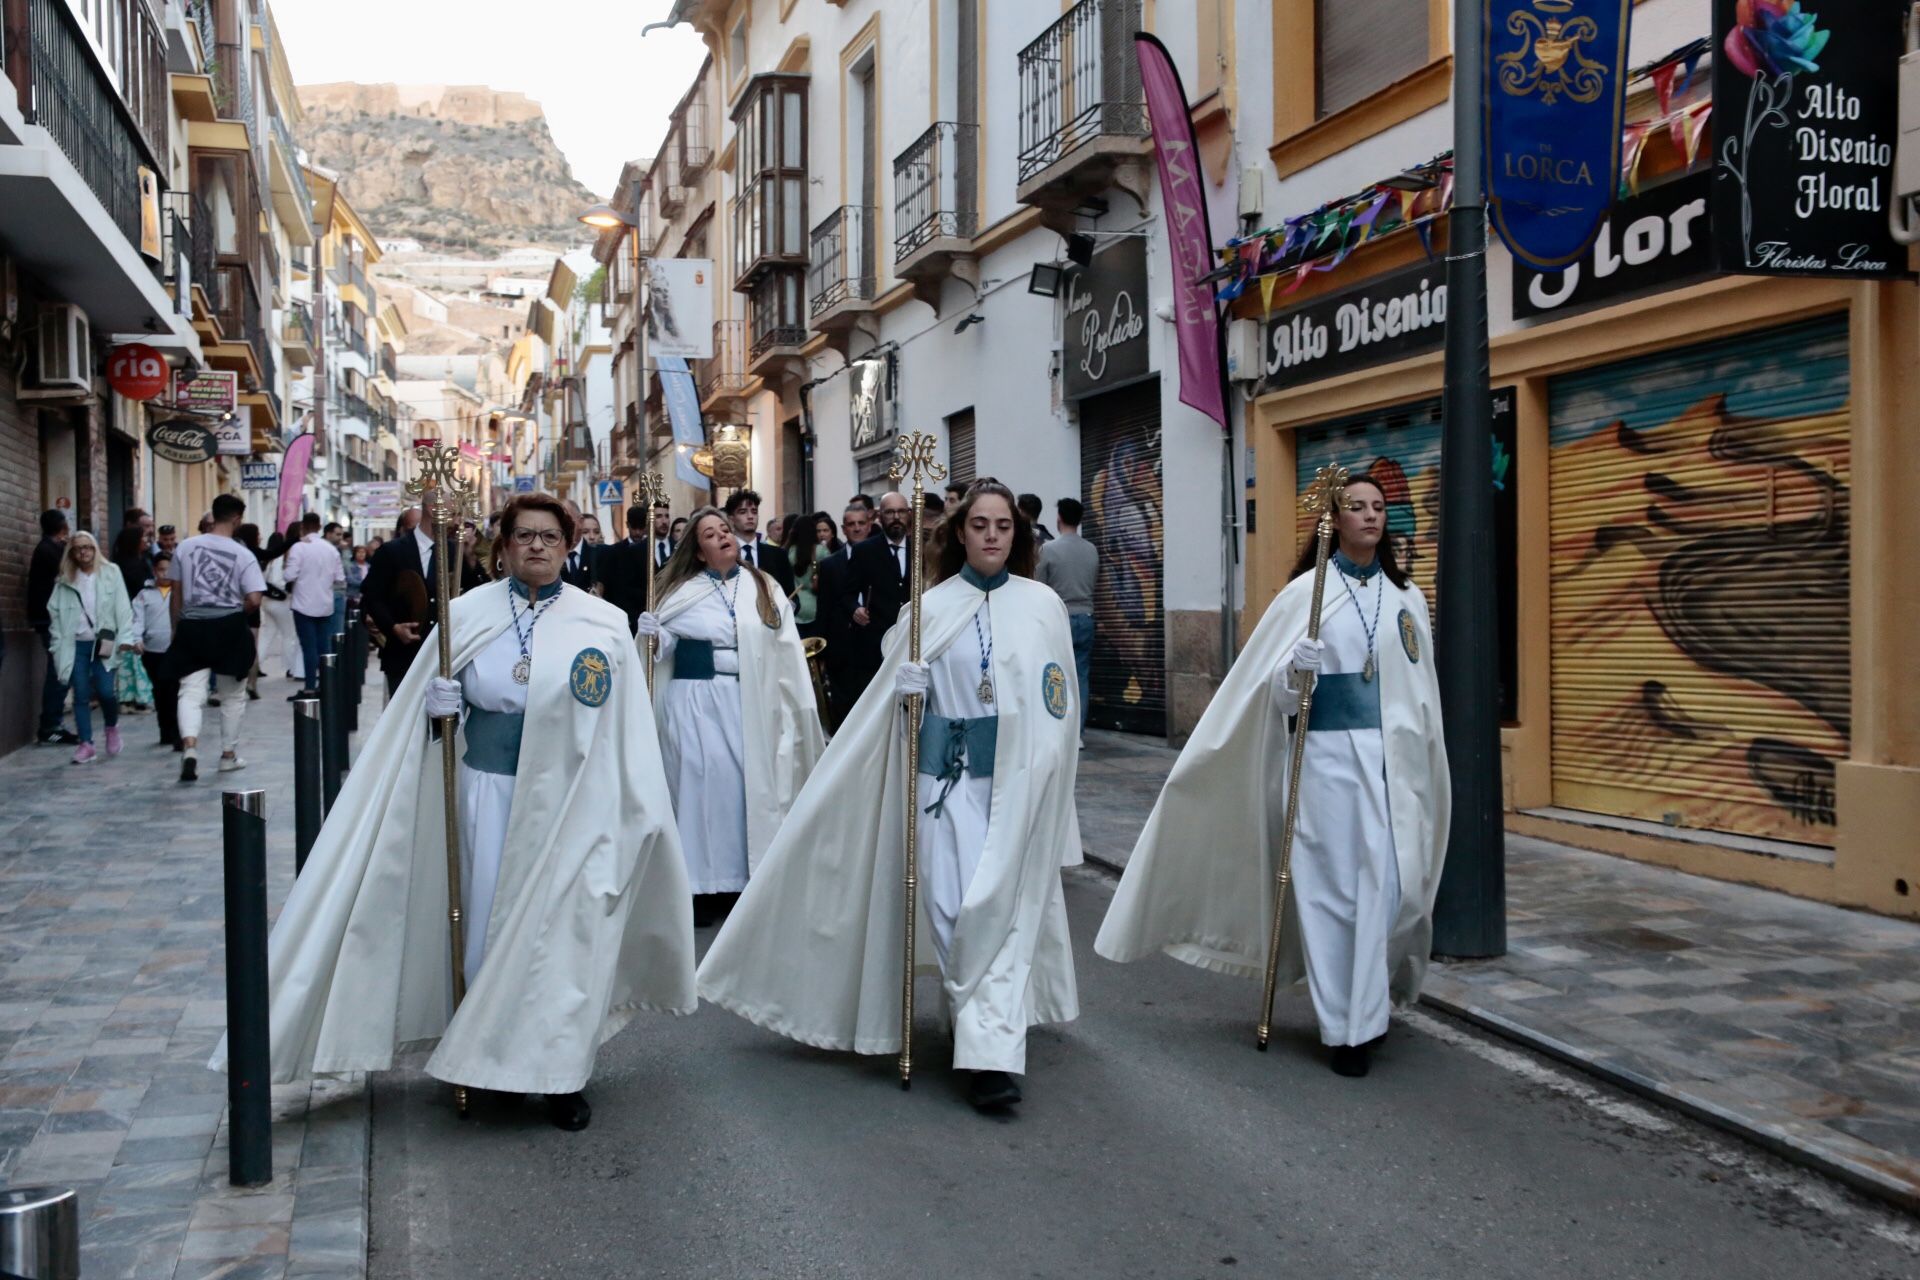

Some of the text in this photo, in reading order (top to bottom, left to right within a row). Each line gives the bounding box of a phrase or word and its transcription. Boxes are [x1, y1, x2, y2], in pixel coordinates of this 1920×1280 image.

[1797, 82, 1860, 120] Alto
[1796, 127, 1891, 167] Disenio
[1504, 152, 1594, 186] LORCA
[1795, 172, 1881, 218] Floral
[1747, 241, 1887, 271] Floristas Lorca
[1080, 290, 1144, 380] Preludio
[1267, 279, 1447, 375] Alto Disenio
[114, 349, 160, 377] ria
[243, 465, 275, 478] LANAS
